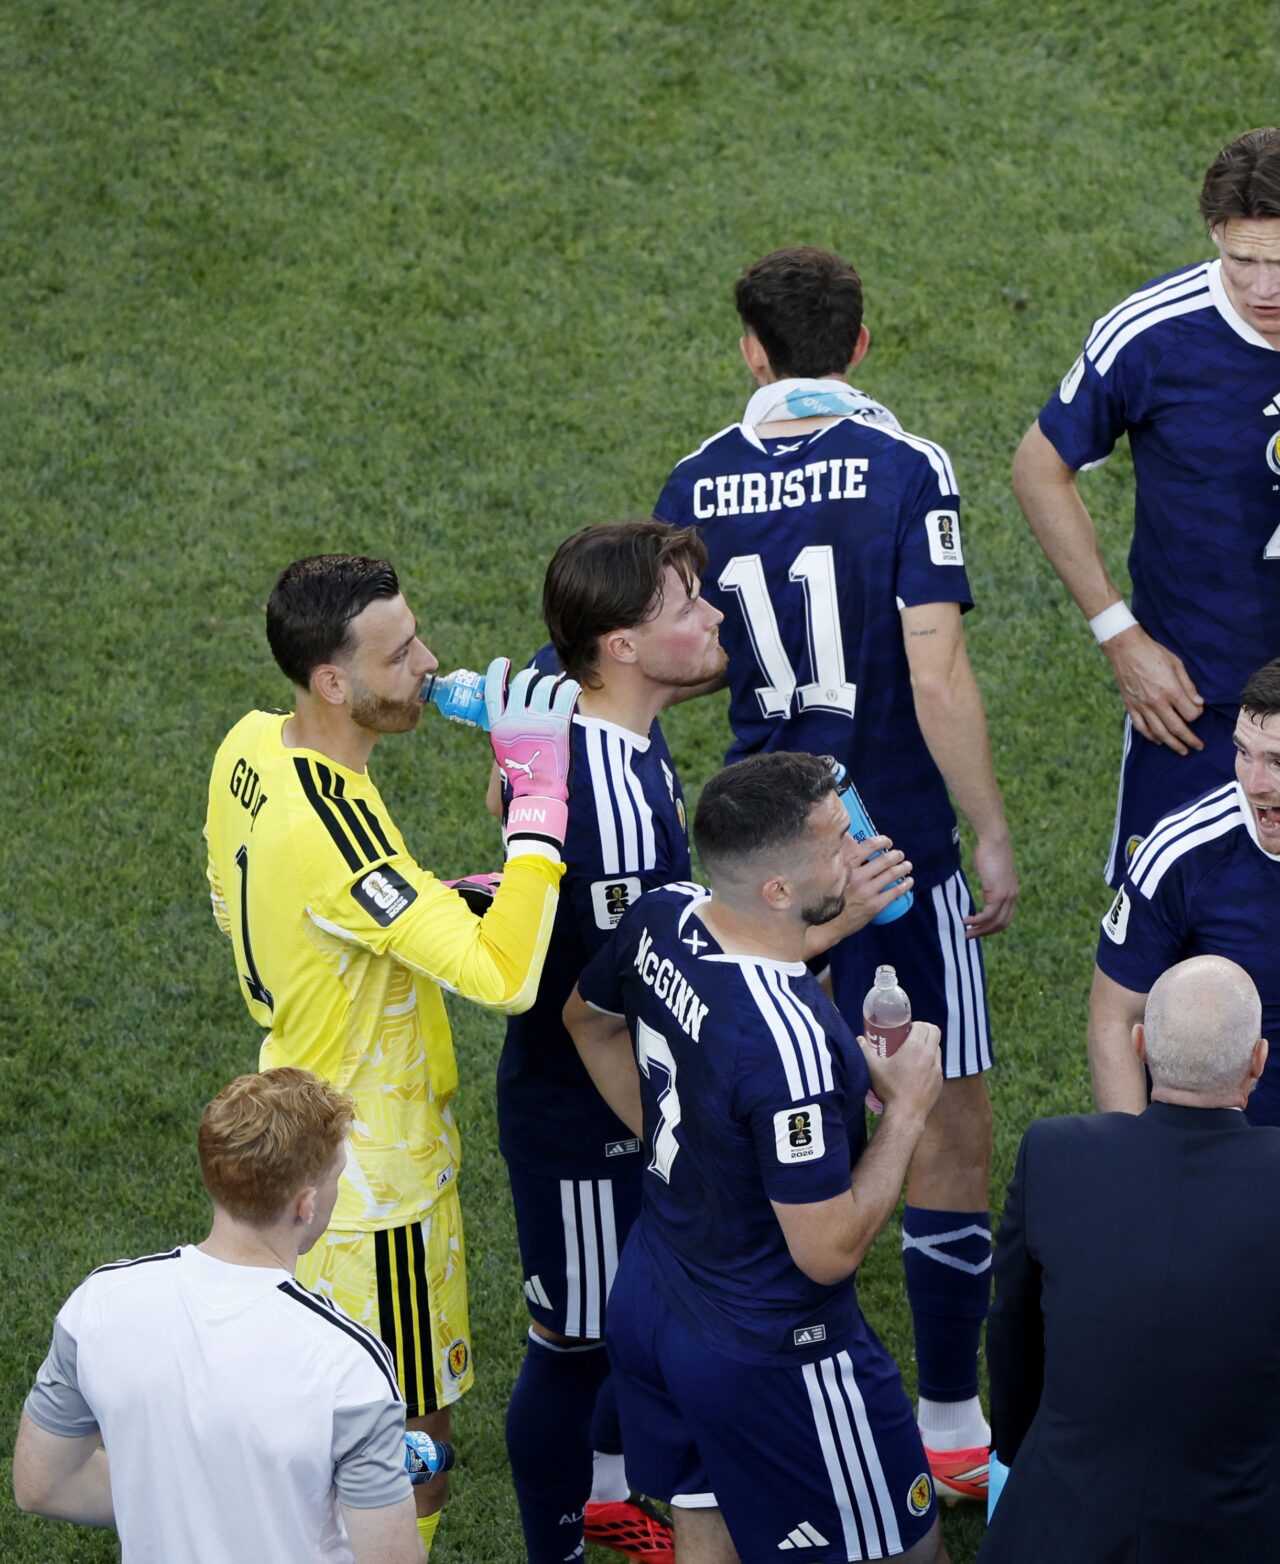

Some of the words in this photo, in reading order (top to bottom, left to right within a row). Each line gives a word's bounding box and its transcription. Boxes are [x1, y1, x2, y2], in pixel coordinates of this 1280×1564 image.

[693, 458, 869, 519] CHRISTIE
[718, 545, 857, 719] 11
[507, 807, 547, 824] UNN
[636, 1015, 682, 1185] 7
[791, 1150, 814, 1158] 2026
